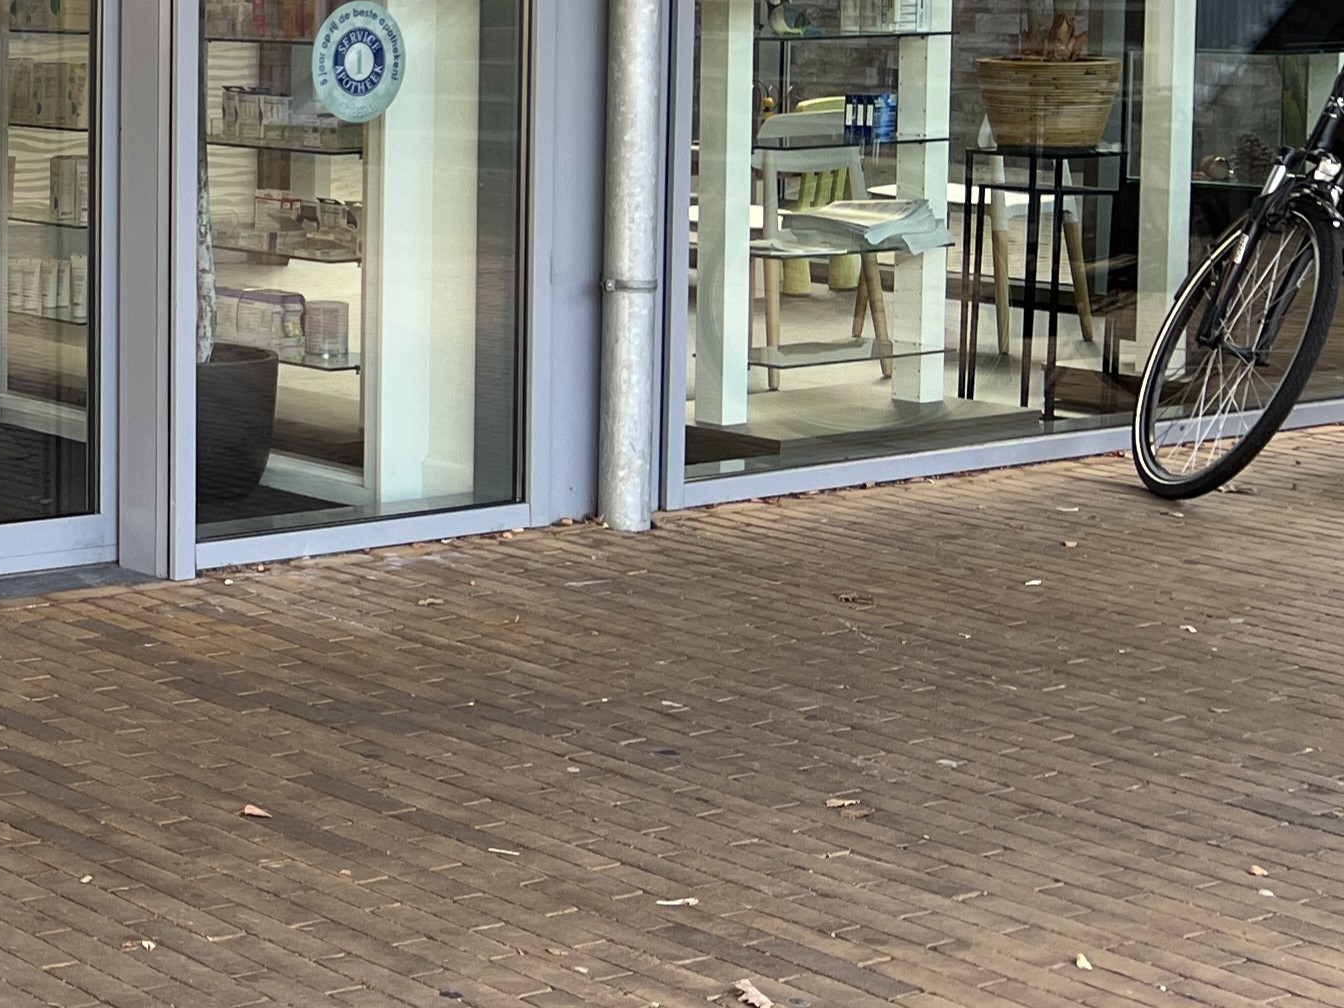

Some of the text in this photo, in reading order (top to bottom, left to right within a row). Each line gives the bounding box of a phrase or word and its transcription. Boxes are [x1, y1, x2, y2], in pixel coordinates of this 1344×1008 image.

[338, 12, 350, 24] de
[352, 8, 378, 20] beste
[329, 21, 339, 33] rij
[321, 33, 331, 49] op
[338, 30, 381, 55] SERVICE
[379, 18, 402, 81] apotheken!
[317, 52, 328, 77] jaar
[354, 48, 363, 75] 1
[334, 64, 384, 93] APOTHEEK
